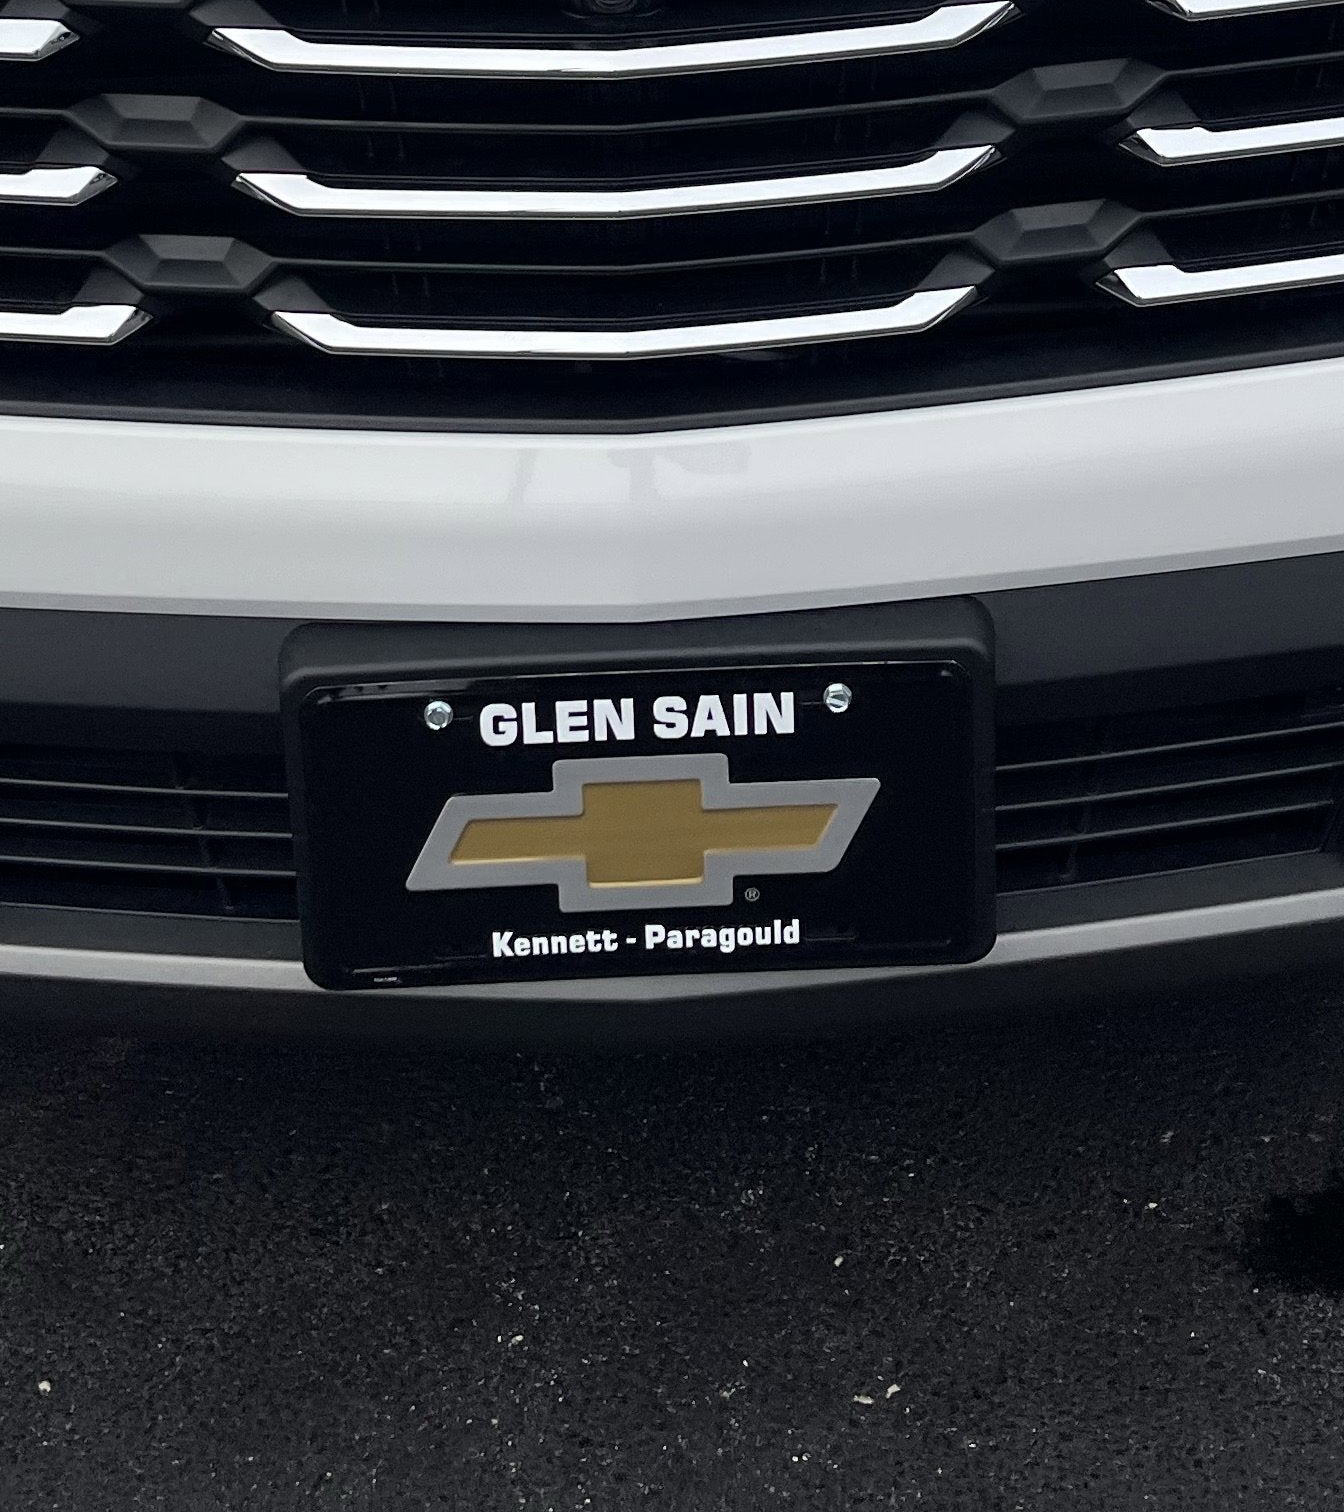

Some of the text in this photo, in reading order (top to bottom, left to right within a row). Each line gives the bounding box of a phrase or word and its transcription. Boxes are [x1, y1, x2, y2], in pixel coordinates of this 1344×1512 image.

[479, 691, 795, 747] GLEN SAIN
[492, 929, 618, 958] Kennett
[644, 918, 800, 953] Paragould
